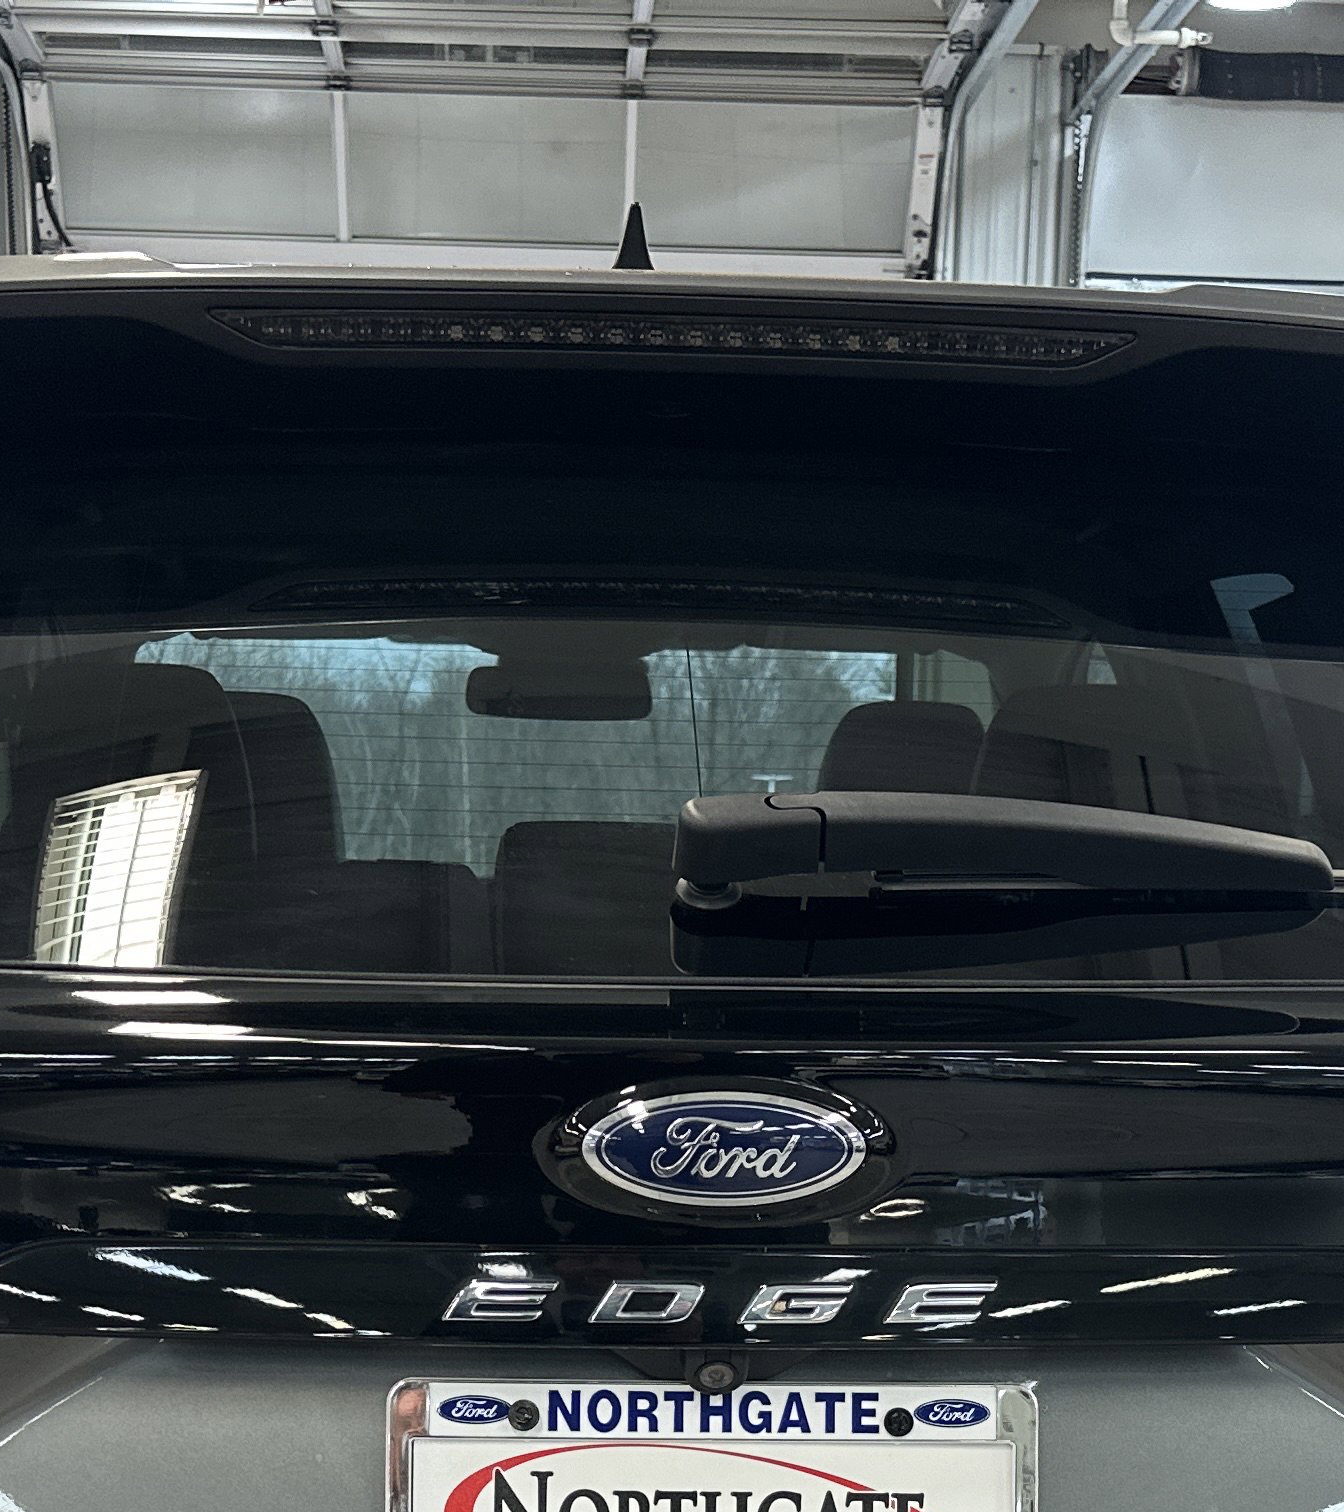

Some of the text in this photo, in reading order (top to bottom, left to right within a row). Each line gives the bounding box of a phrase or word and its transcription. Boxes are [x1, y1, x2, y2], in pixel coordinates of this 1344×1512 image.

[650, 1116, 800, 1180] Ford
[441, 1279, 999, 1325] EDGE
[451, 1389, 975, 1434] Ford NORTHGATE Ford
